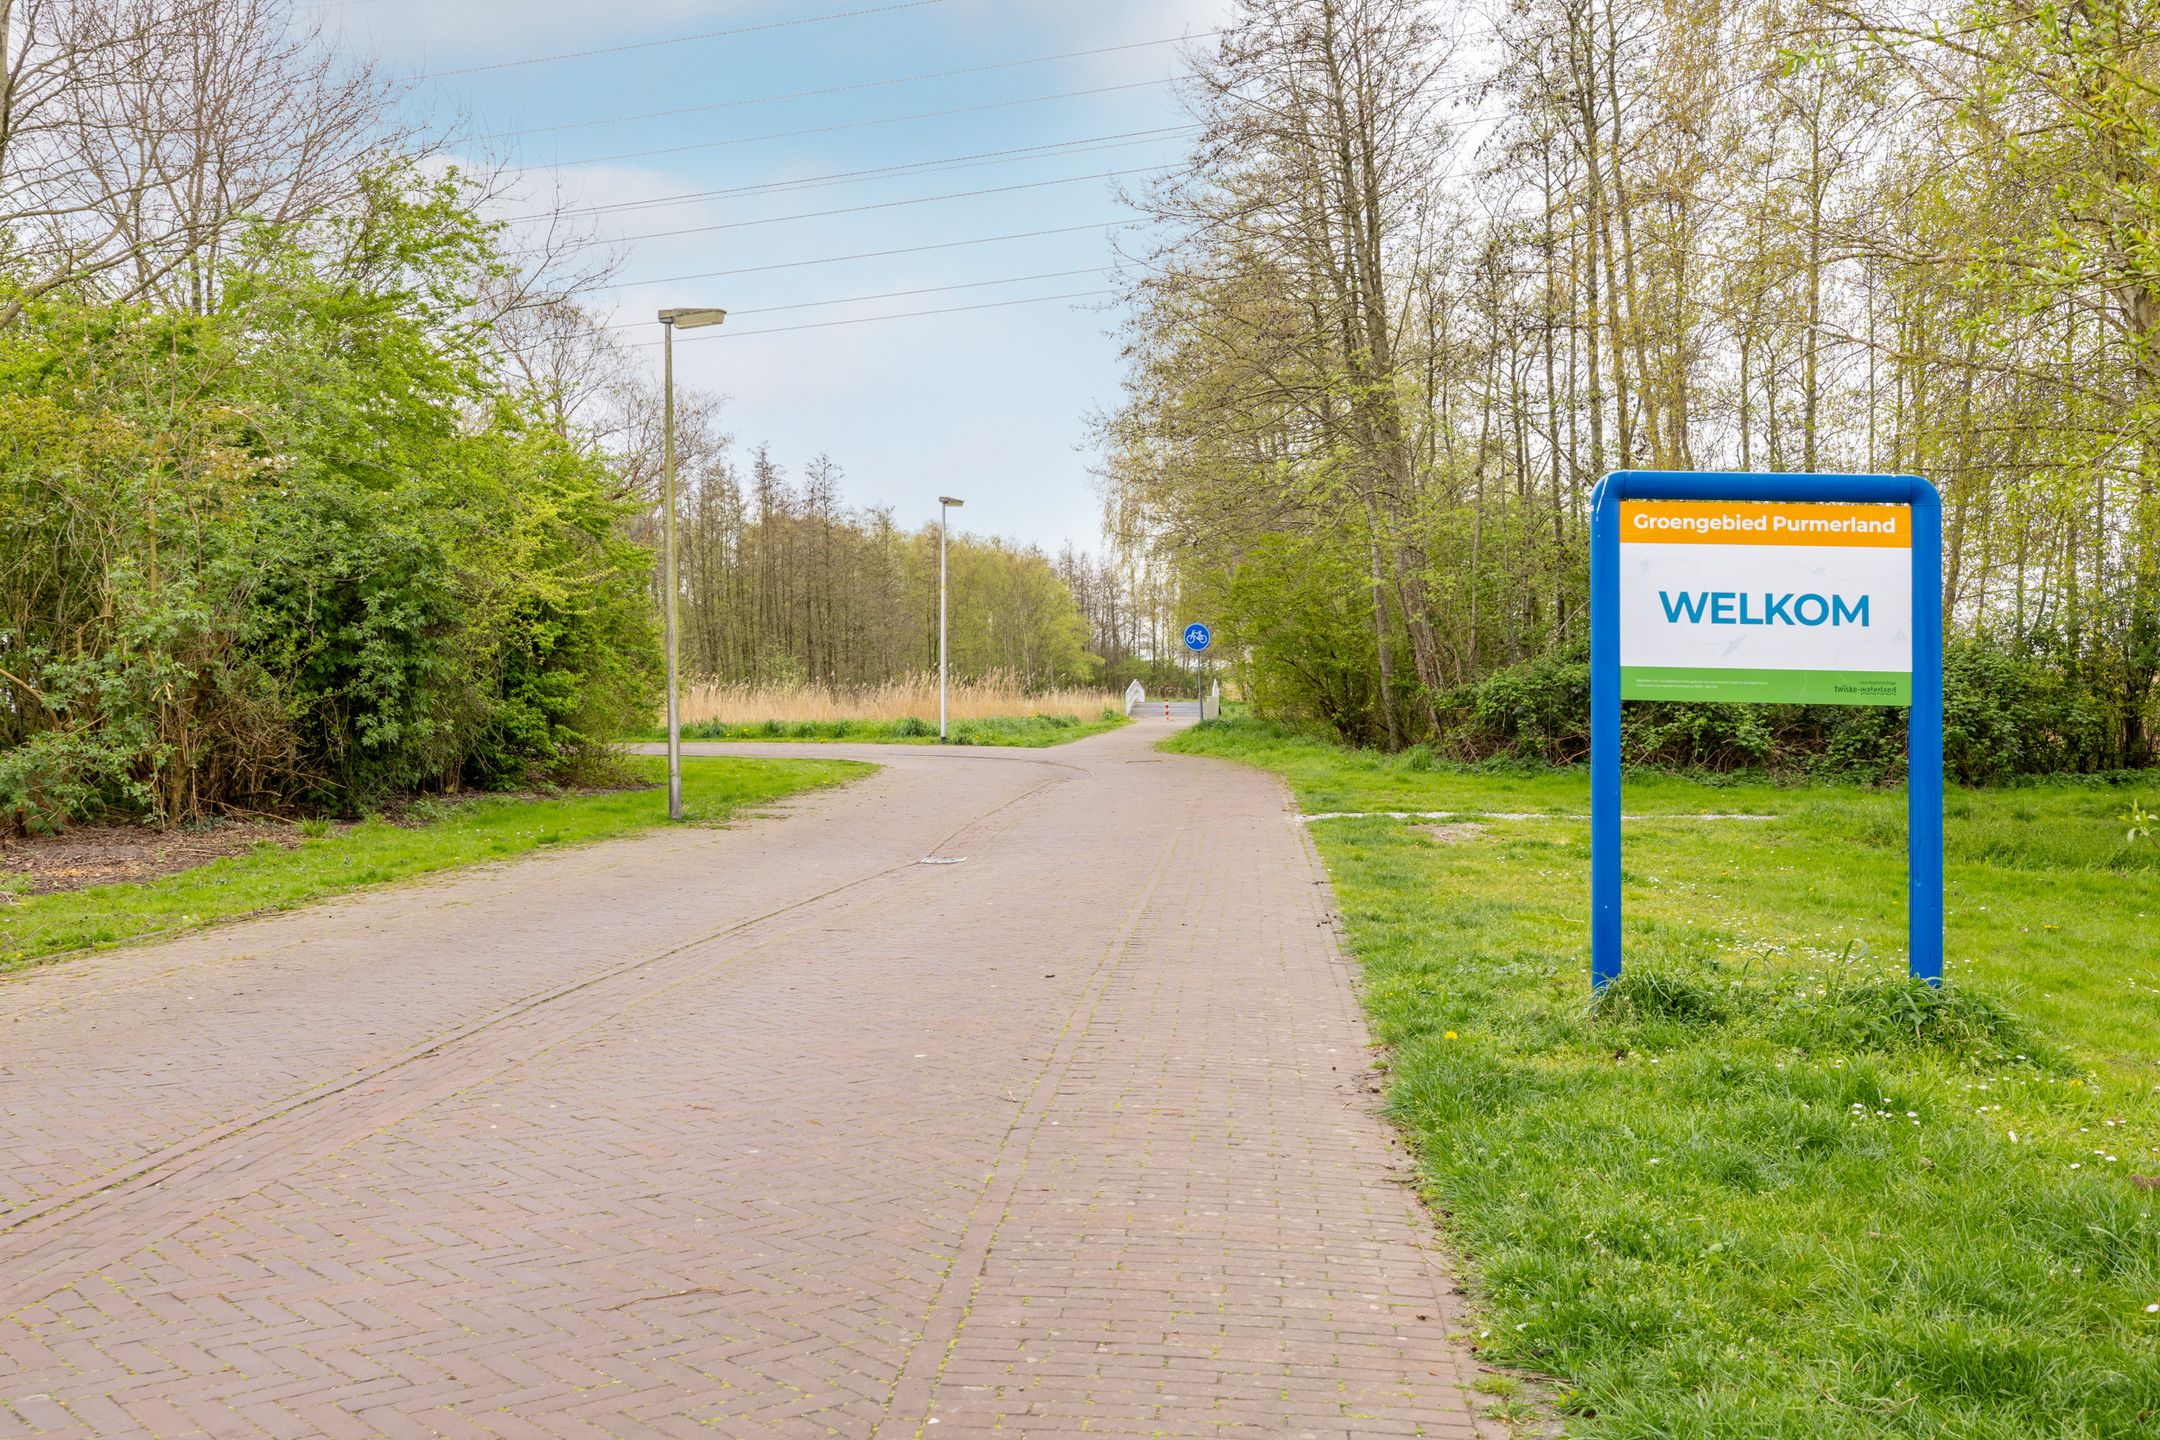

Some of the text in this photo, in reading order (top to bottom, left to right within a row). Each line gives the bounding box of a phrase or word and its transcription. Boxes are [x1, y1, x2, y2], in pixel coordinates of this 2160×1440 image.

[1633, 513, 1896, 534] Groengebied Purmerland
[1658, 591, 1870, 627] WELKOM
